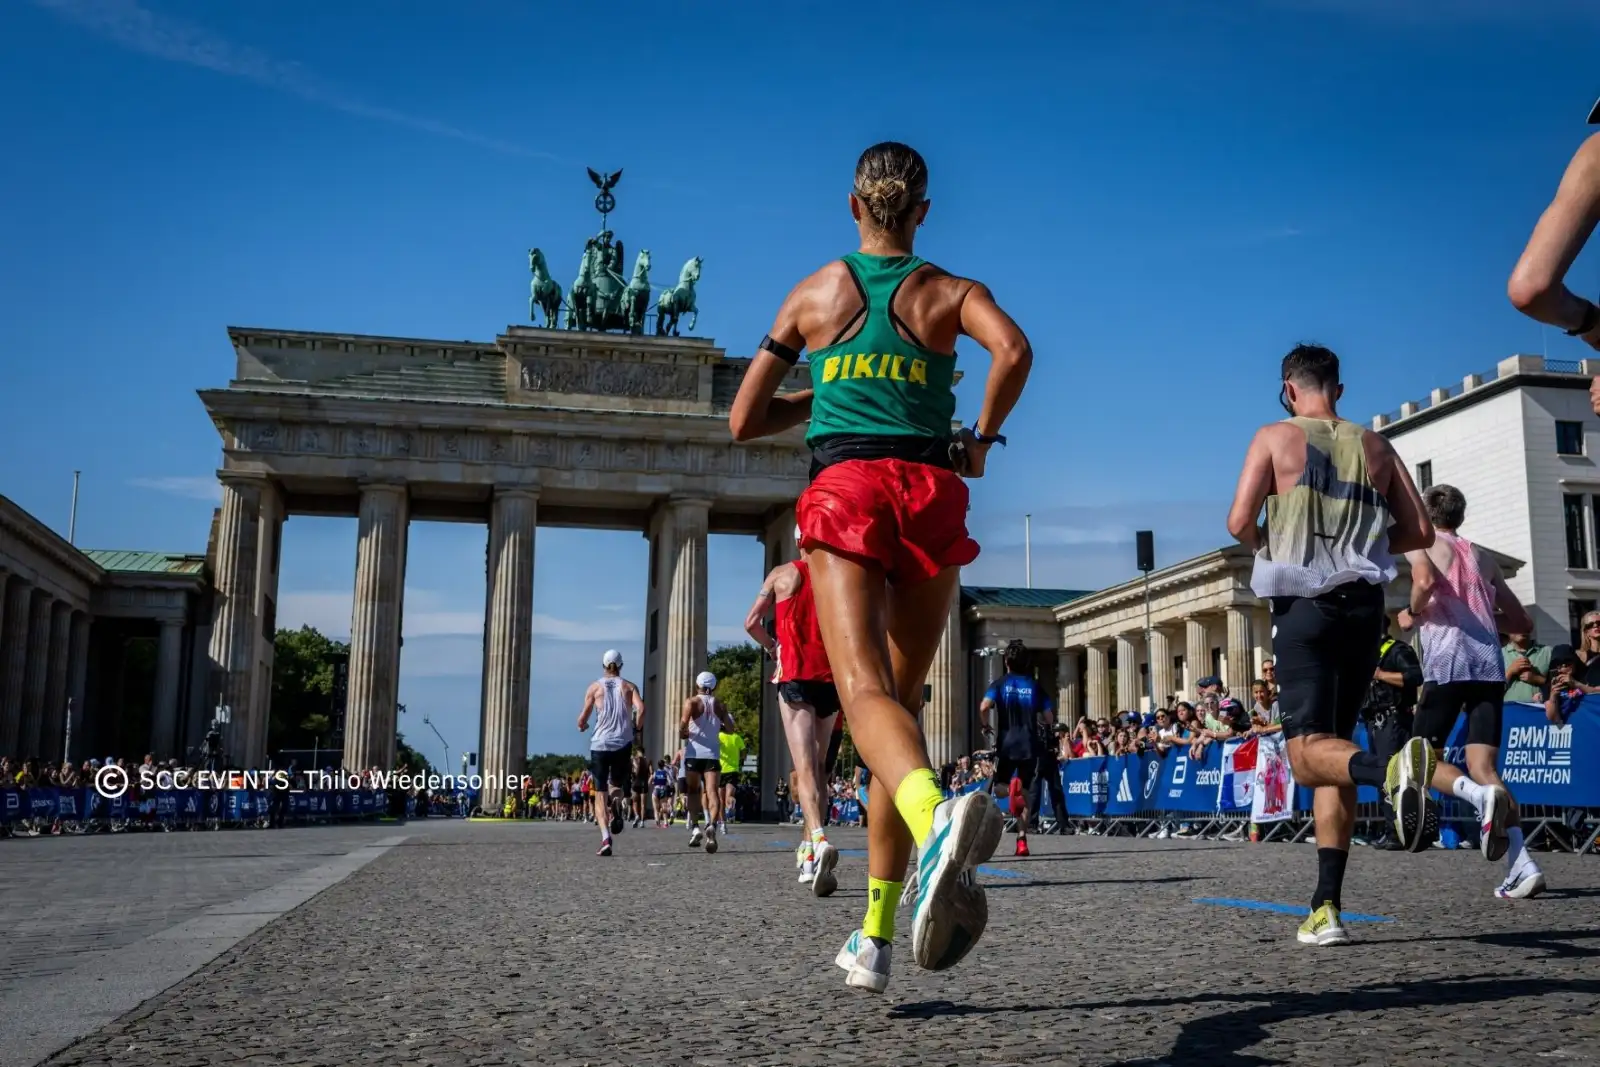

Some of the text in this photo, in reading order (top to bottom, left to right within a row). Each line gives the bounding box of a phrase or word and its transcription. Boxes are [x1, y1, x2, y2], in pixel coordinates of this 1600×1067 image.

[822, 353, 927, 385] BIKILA
[1507, 725, 1547, 749] BMW
[1504, 750, 1546, 766] BERLIN
[1501, 768, 1571, 785] MARATHON
